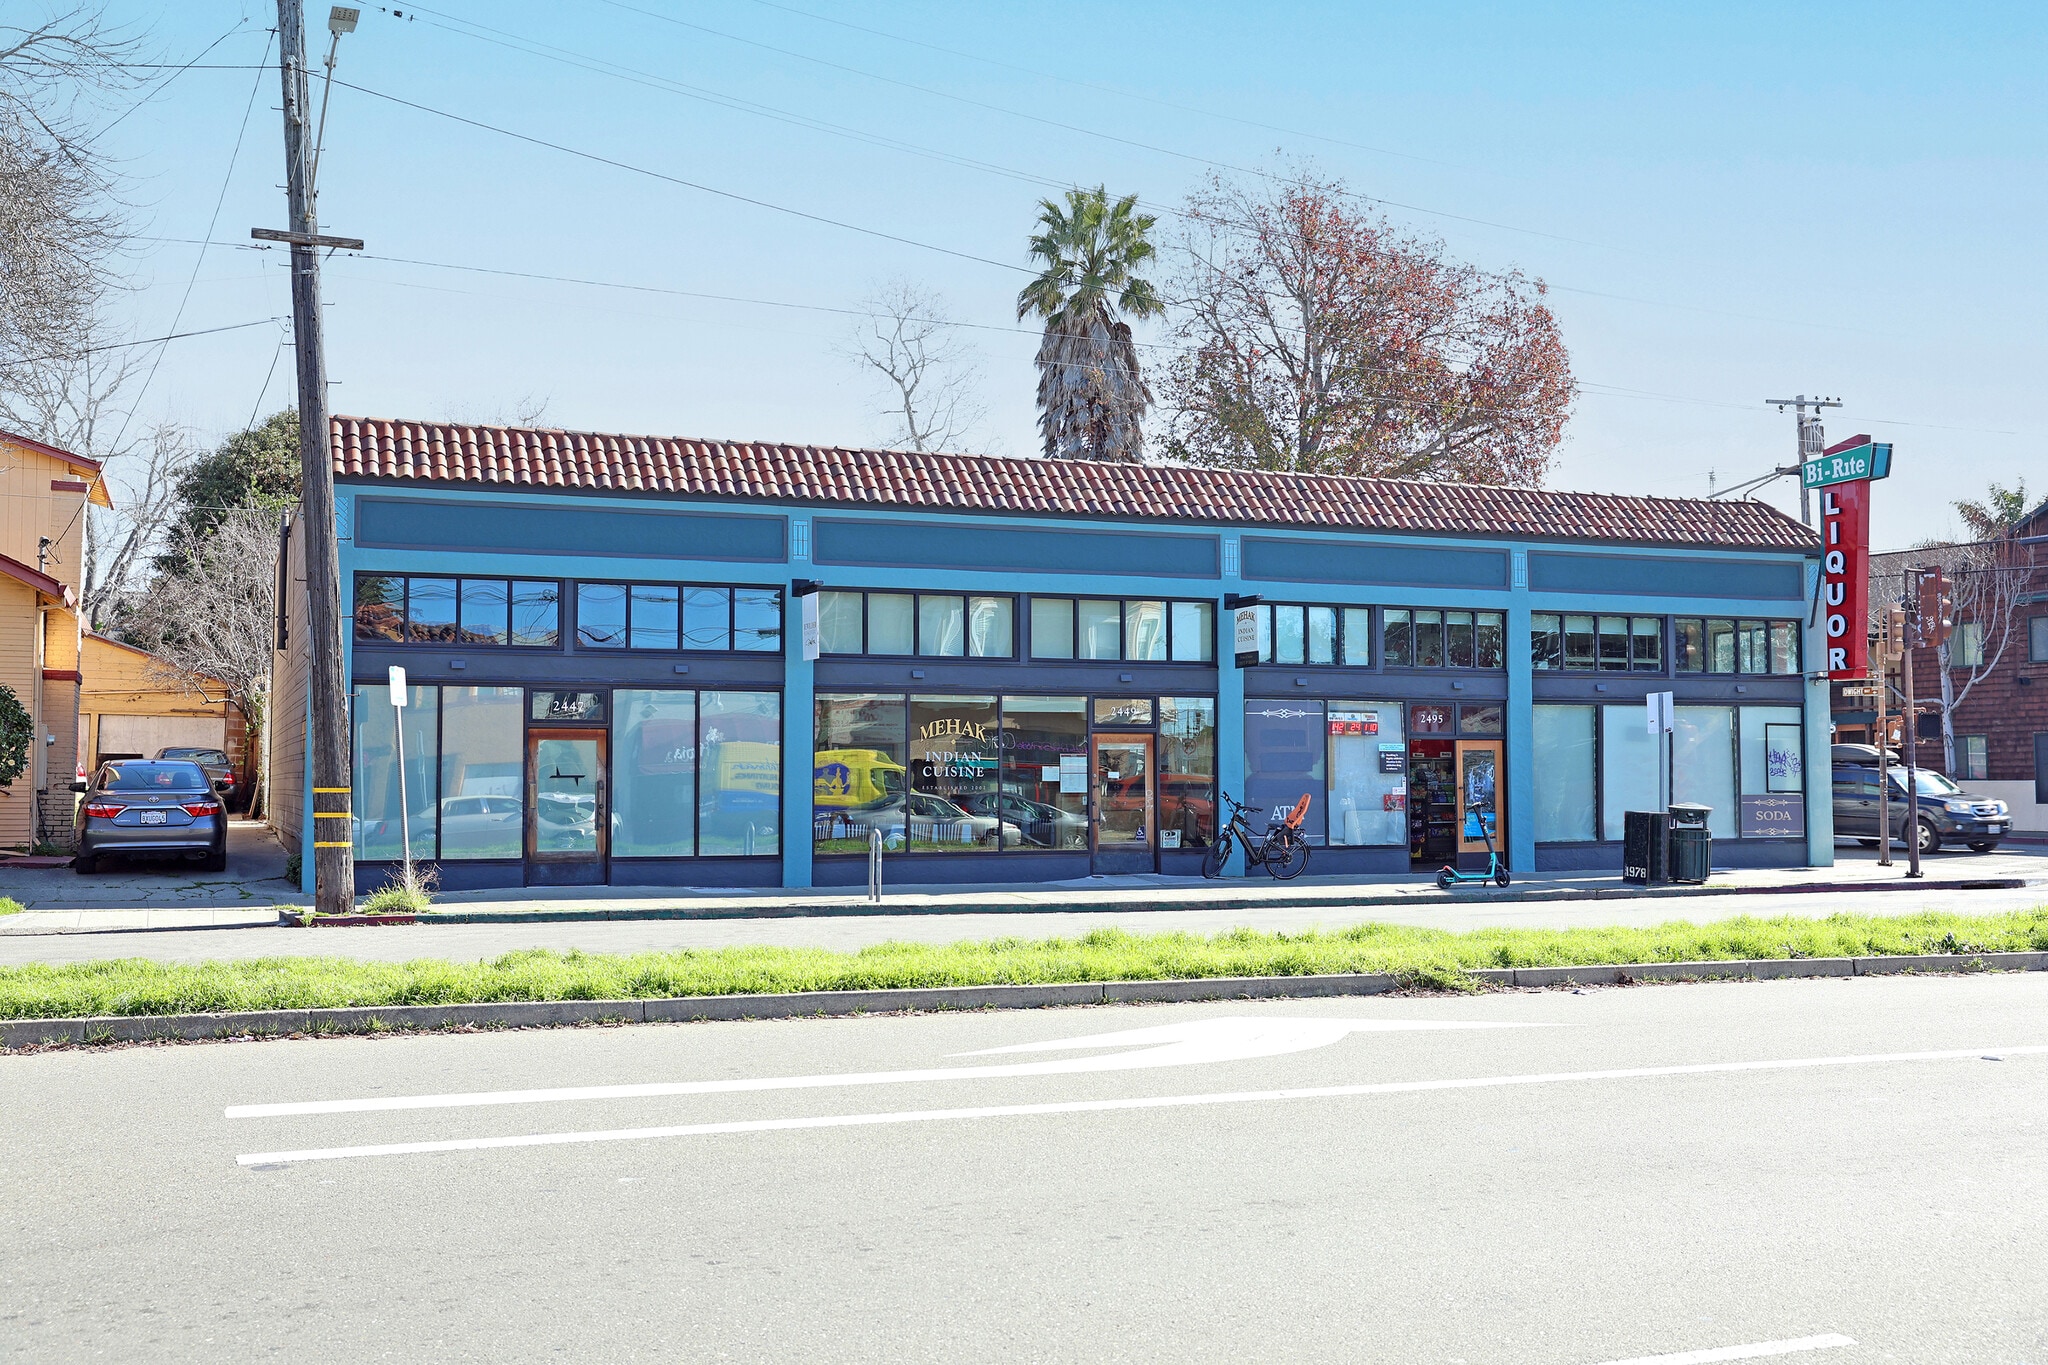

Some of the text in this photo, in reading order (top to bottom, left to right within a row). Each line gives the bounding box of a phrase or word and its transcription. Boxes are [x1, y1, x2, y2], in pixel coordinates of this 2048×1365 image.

[1806, 456, 1865, 484] Bi-Rite
[1825, 492, 1847, 670] LIQUOR
[1236, 610, 1256, 625] MEHAK
[1111, 706, 1137, 717] 2449
[1420, 714, 1443, 724] 2495
[920, 718, 986, 743] MEHAK
[925, 751, 982, 762] INDIAN
[922, 766, 985, 778] CUISINE
[1755, 810, 1792, 821] SODA
[1625, 866, 1647, 879] 1978
